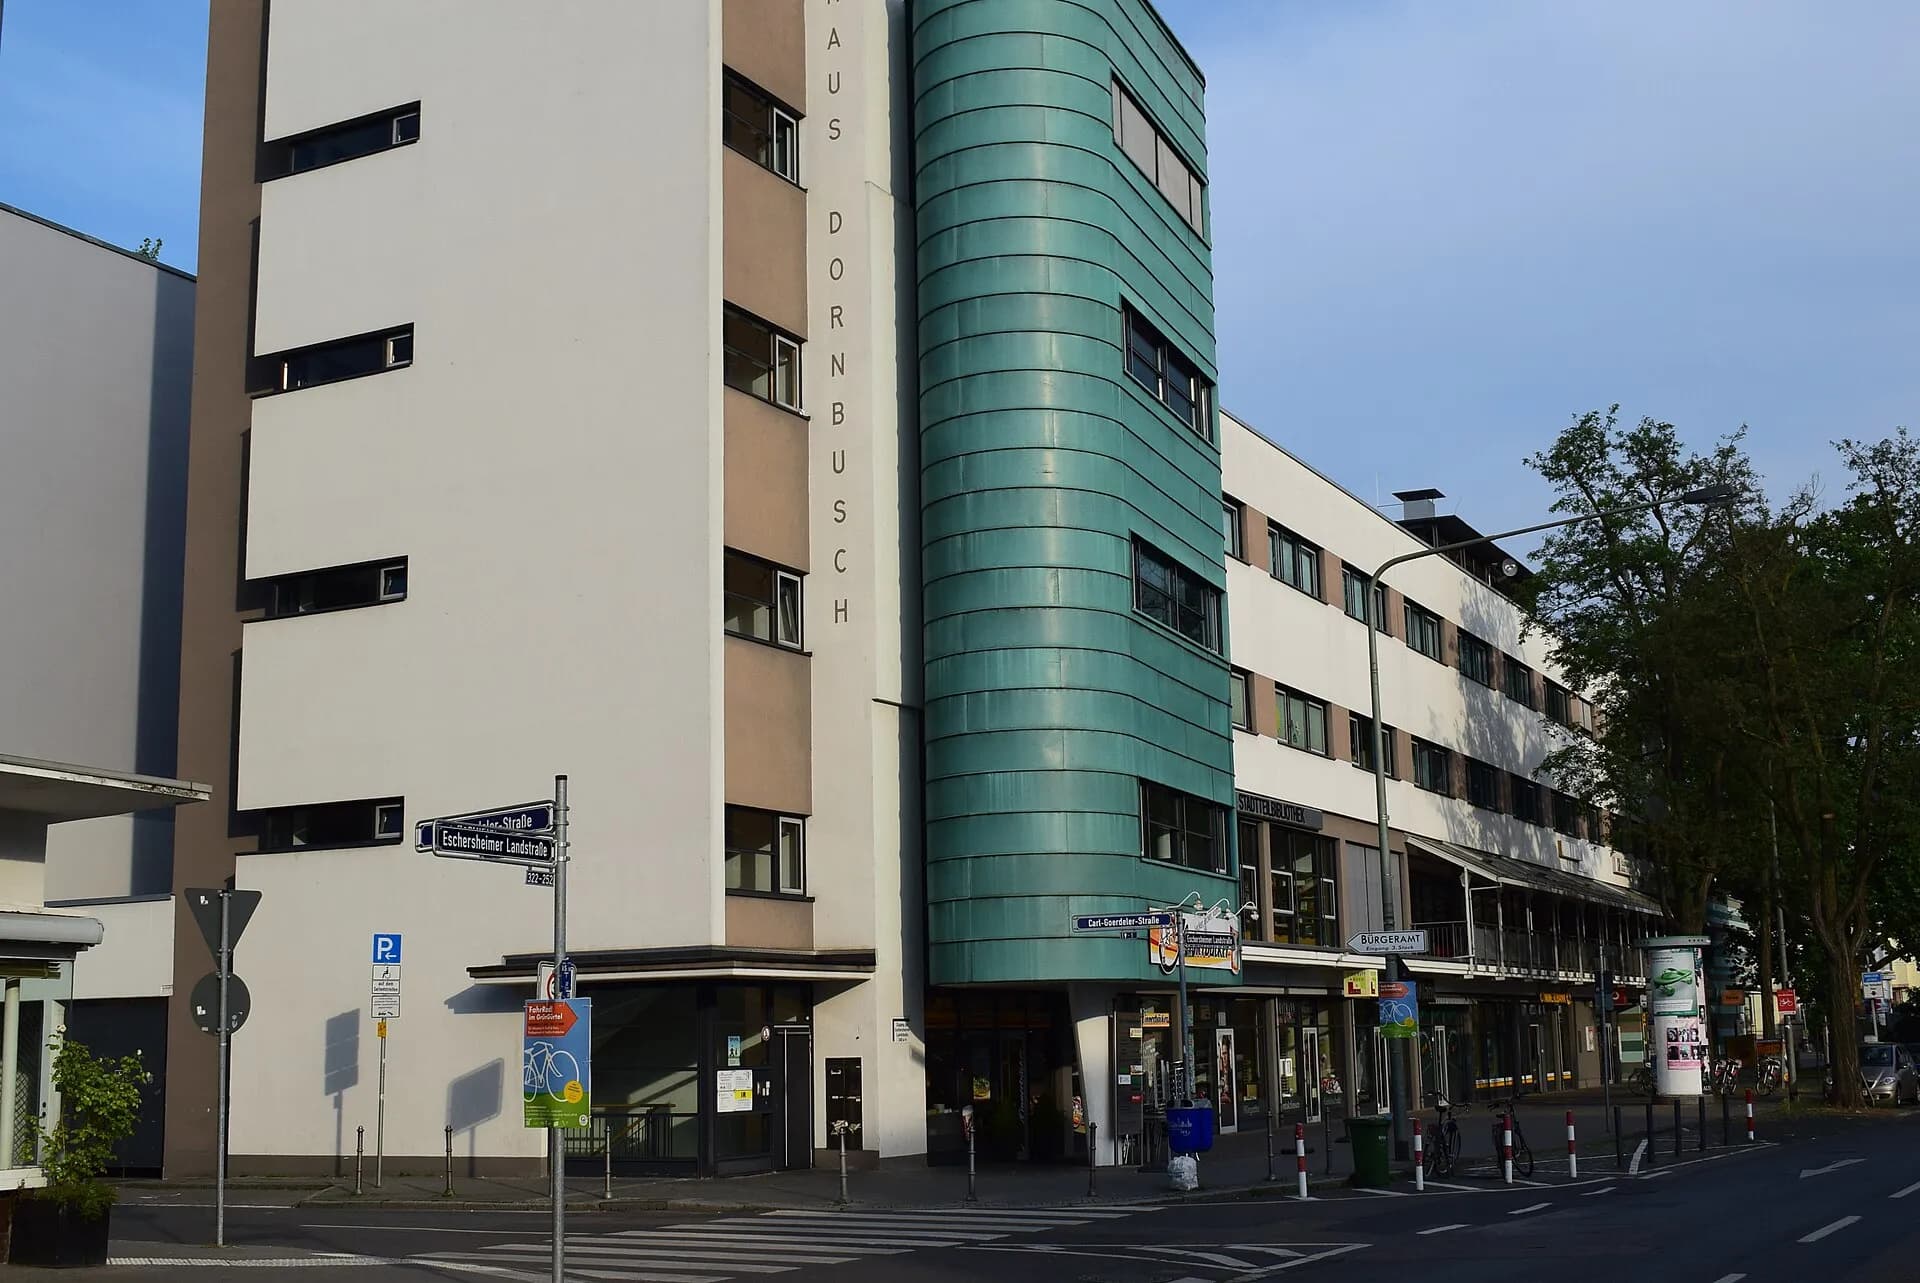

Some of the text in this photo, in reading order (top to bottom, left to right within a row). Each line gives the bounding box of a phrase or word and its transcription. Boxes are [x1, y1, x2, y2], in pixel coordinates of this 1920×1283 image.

[827, 0, 841, 140] AUS
[829, 211, 848, 624] DORNBUSCH
[442, 831, 548, 857] Eschersheimer Landstraße
[1088, 916, 1160, 927] Carl-Goerdeler-Straße
[377, 937, 394, 960] P
[1361, 934, 1421, 945] BÜRGERAMT
